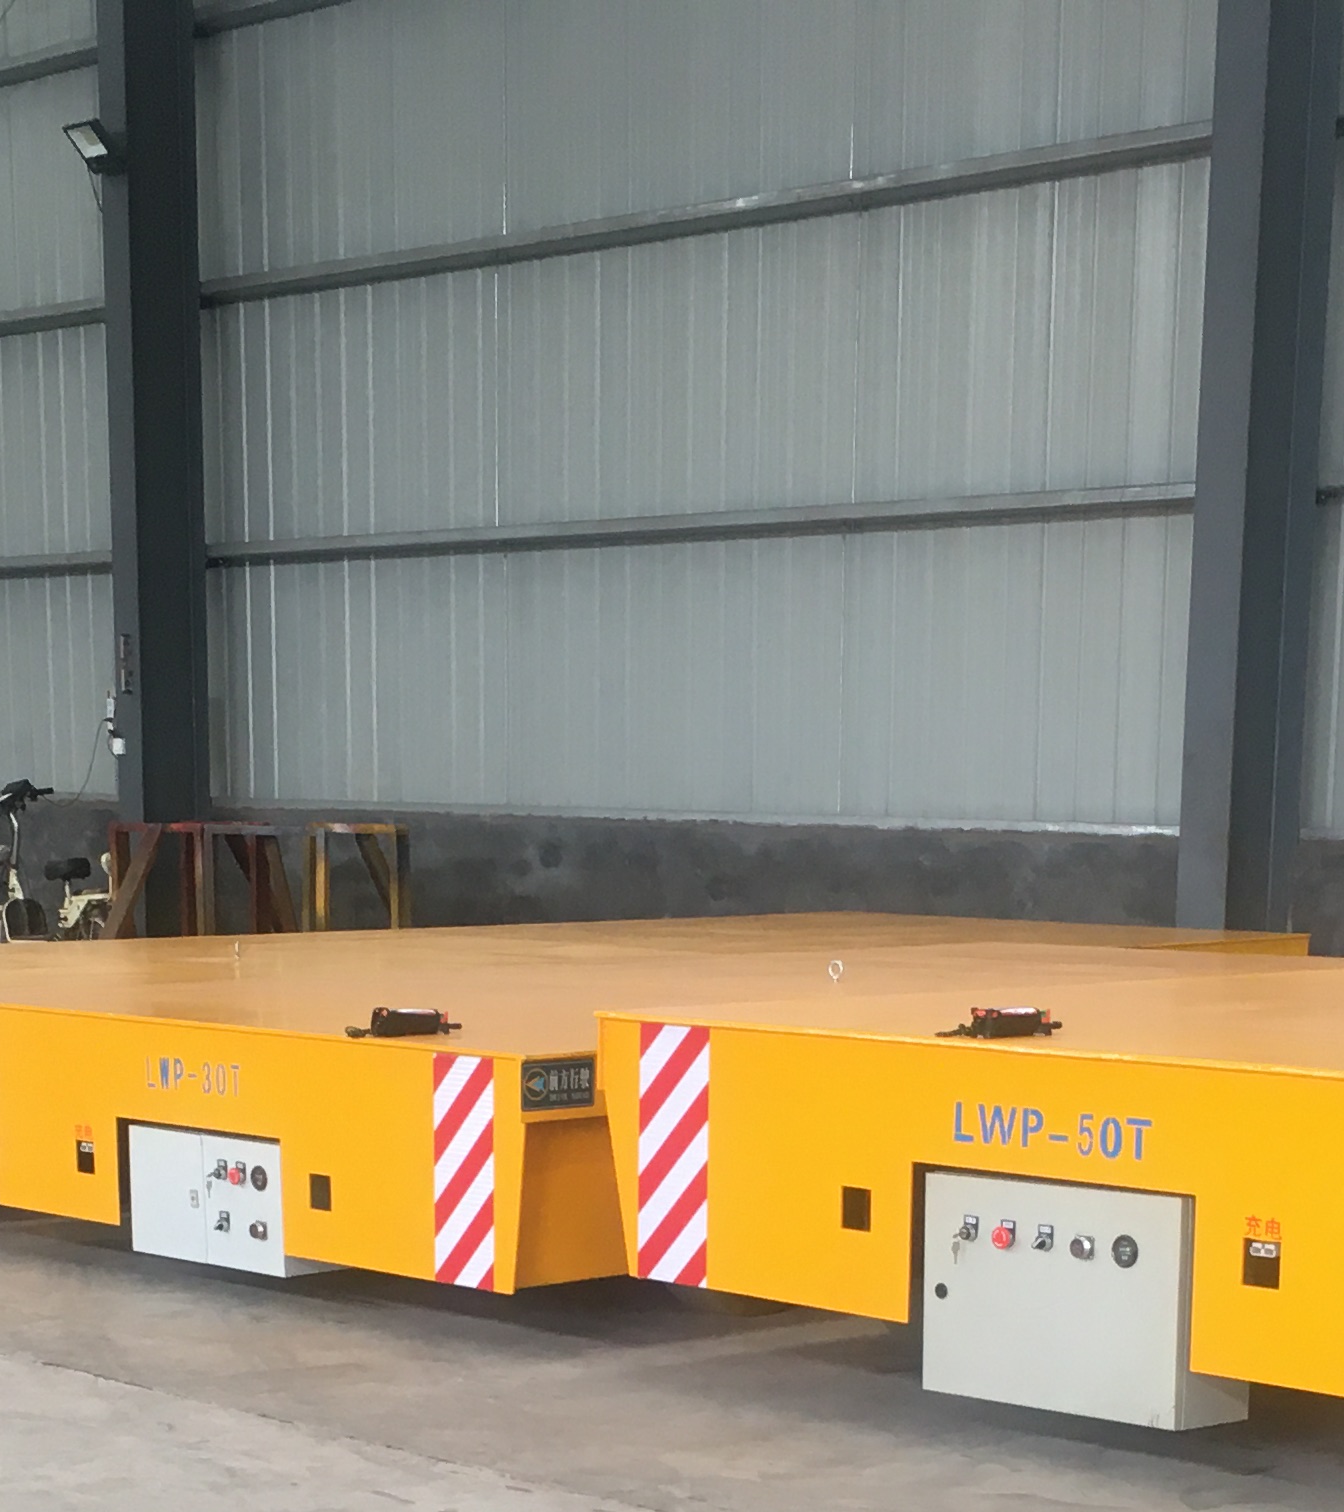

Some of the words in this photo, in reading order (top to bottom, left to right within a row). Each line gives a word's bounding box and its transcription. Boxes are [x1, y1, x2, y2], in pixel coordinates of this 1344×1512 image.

[145, 1055, 240, 1097] LWP-30T
[953, 1101, 1153, 1161] LWP-50T
[1244, 1214, 1282, 1241] 充电
